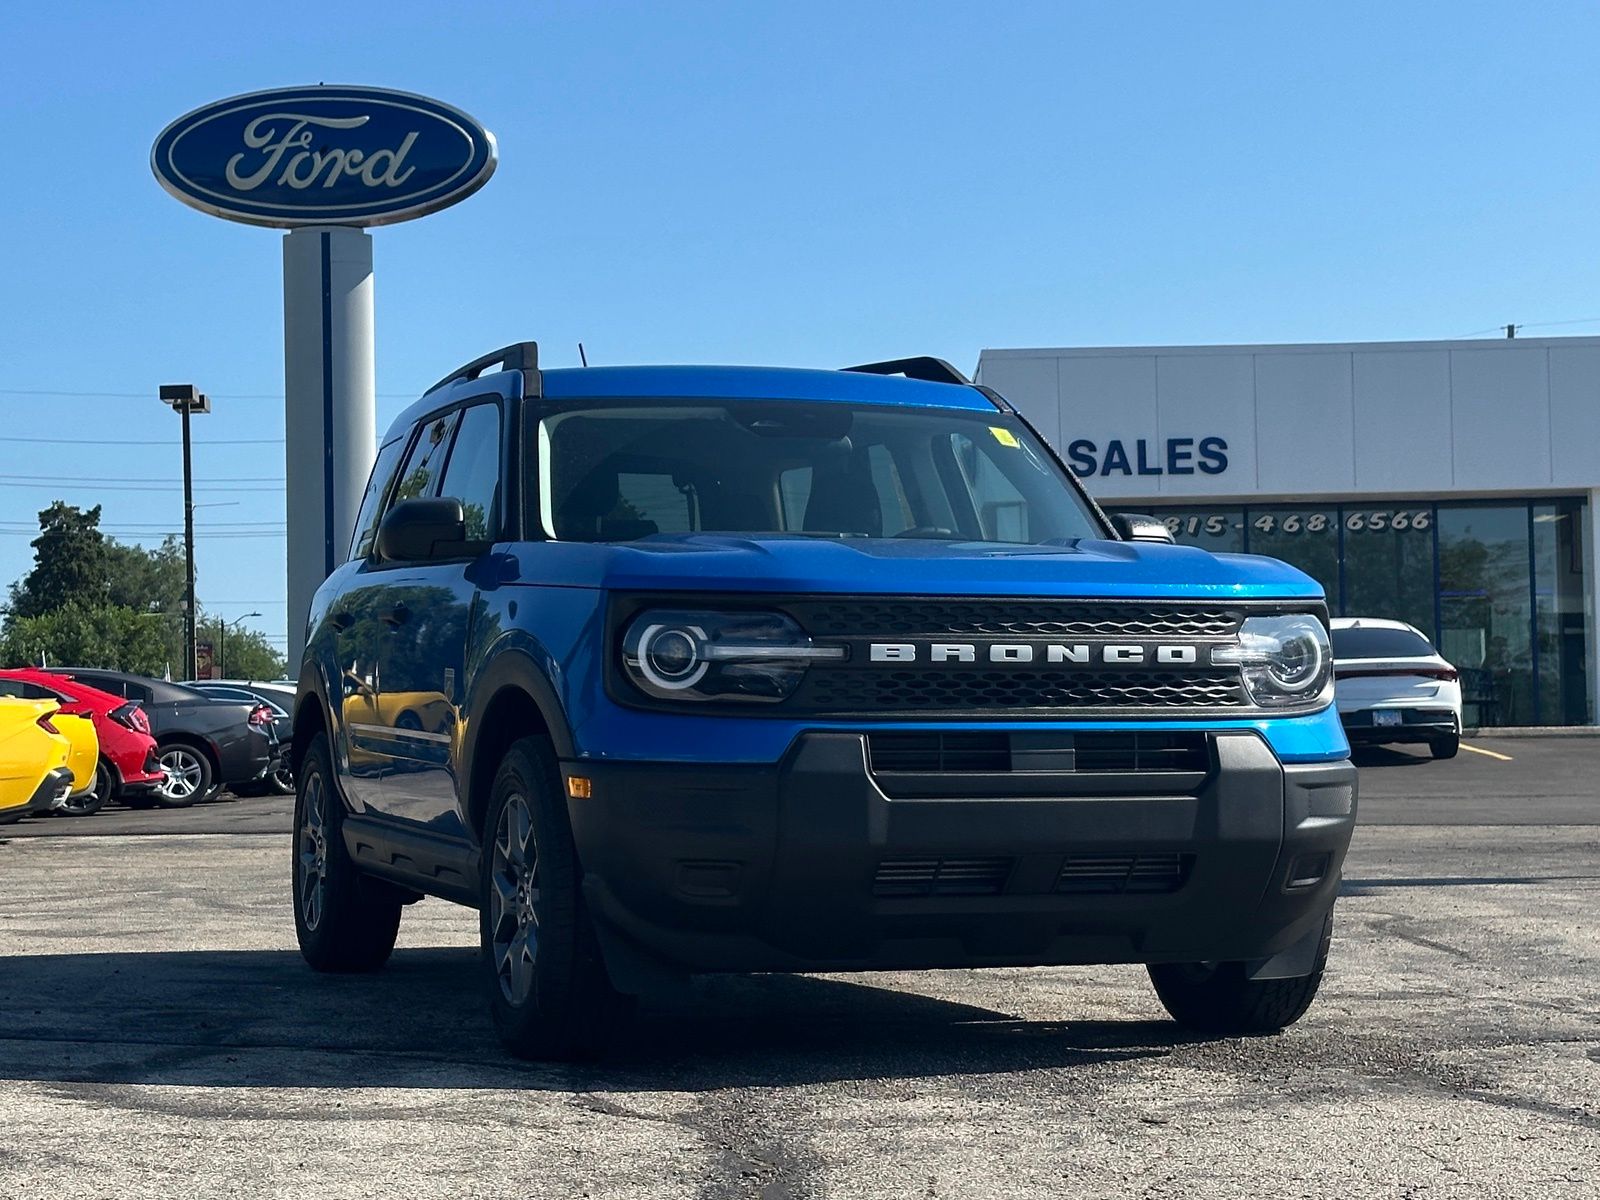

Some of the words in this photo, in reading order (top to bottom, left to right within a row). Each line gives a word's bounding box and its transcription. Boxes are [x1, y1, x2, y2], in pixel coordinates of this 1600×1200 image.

[225, 112, 420, 191] Ford
[1067, 436, 1229, 478] SALES
[870, 643, 1196, 663] BRONCO
